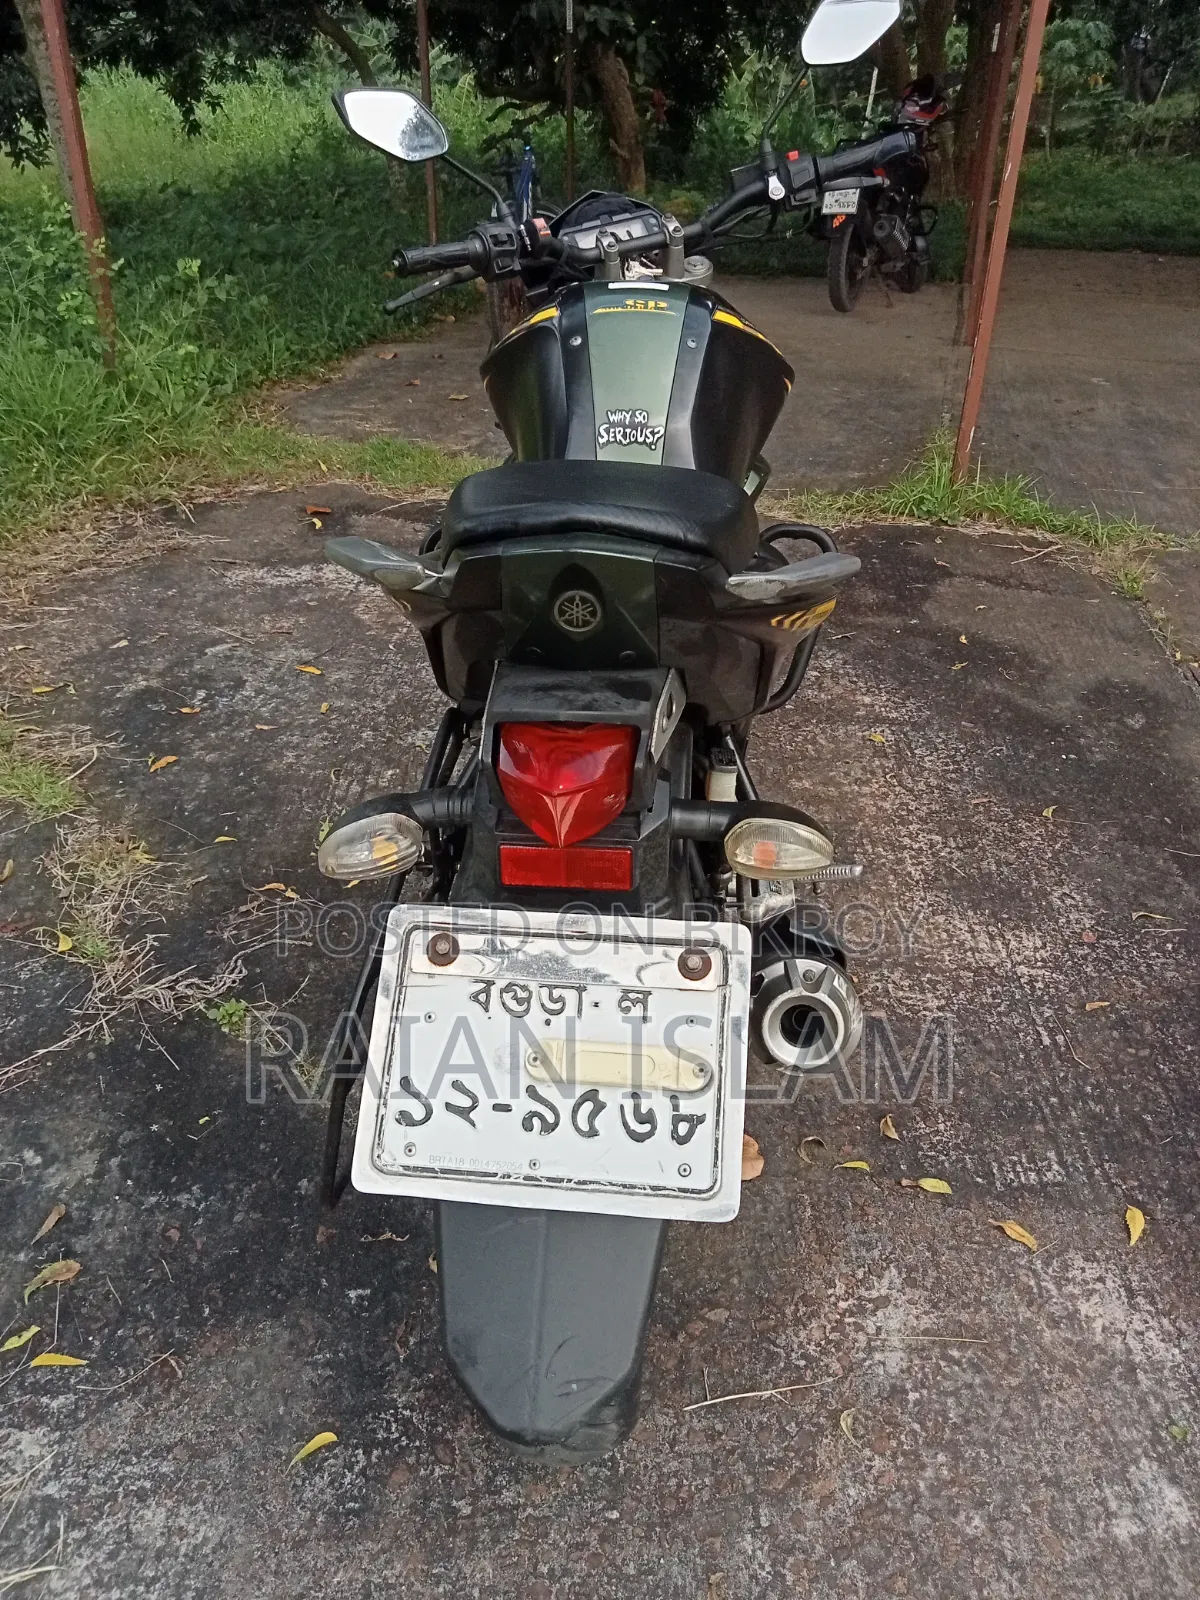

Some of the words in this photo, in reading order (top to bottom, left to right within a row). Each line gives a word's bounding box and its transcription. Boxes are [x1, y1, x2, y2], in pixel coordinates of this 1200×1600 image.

[607, 410, 632, 425] WHY
[635, 410, 648, 424] SO
[598, 423, 664, 449] SERIOUS?
